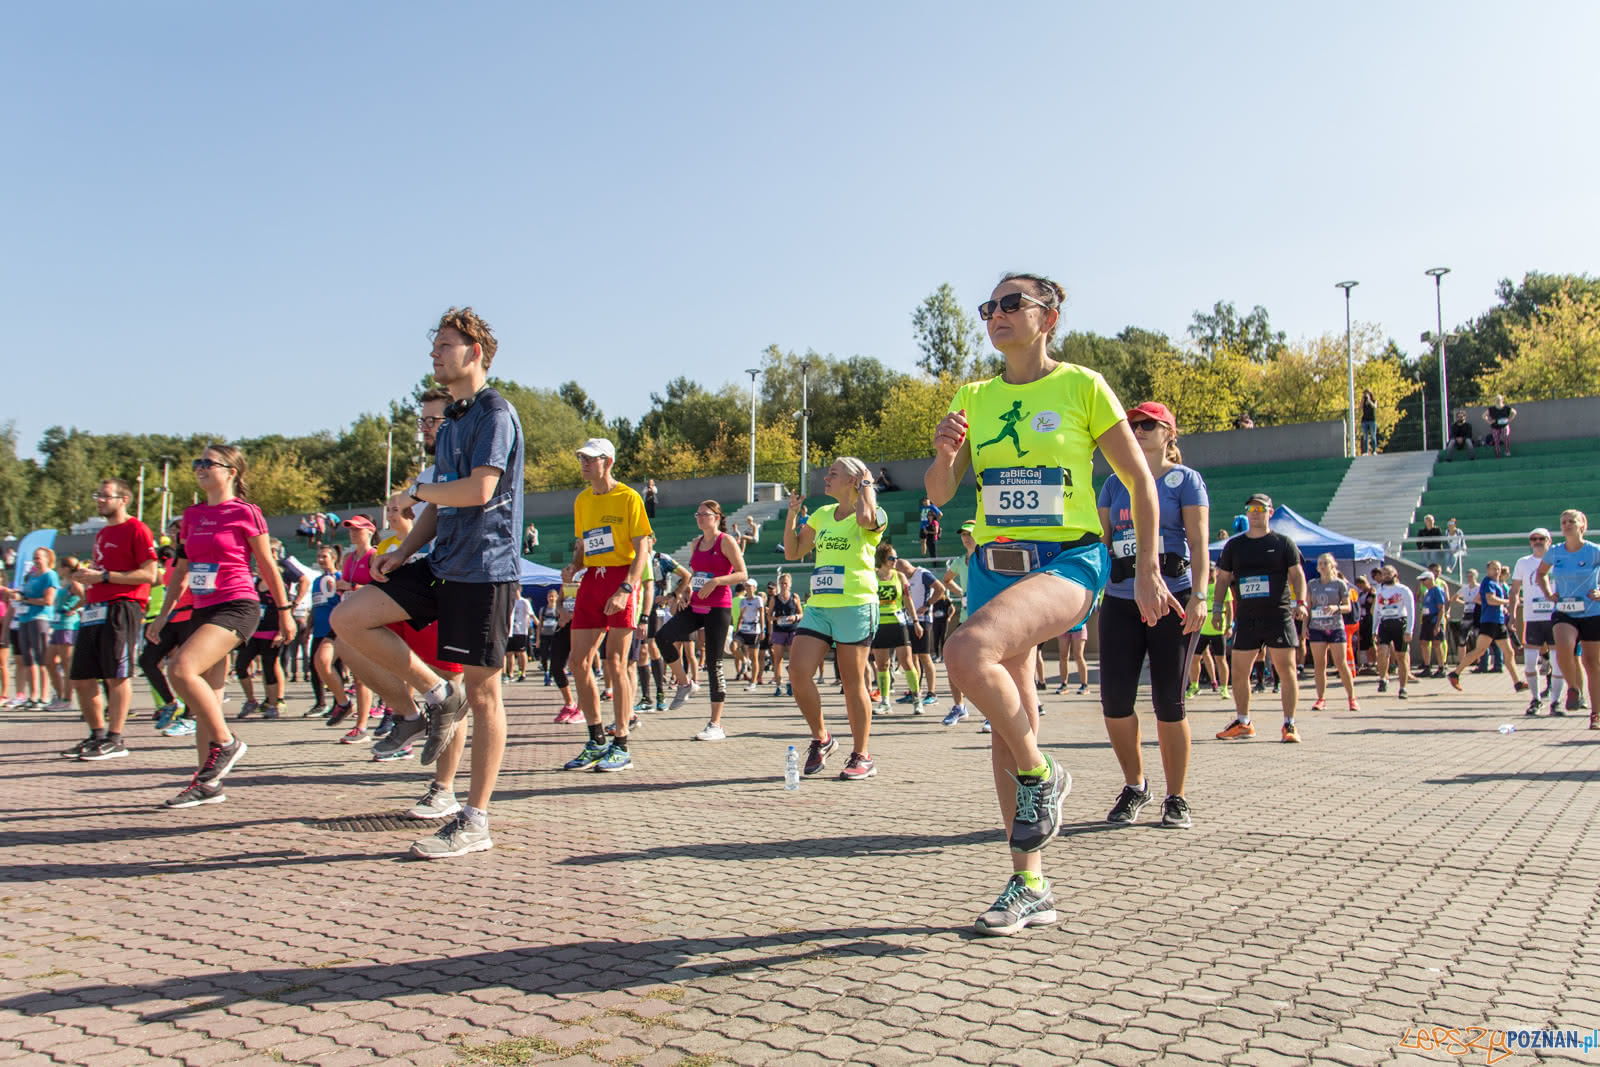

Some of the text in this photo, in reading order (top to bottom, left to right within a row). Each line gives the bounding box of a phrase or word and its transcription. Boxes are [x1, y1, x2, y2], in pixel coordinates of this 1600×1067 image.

[1000, 469, 1042, 479] zaBIEGaj
[999, 490, 1040, 510] 583
[589, 538, 604, 549] 534
[192, 575, 206, 586] 429
[816, 576, 833, 587] 540
[1245, 583, 1261, 592] 272
